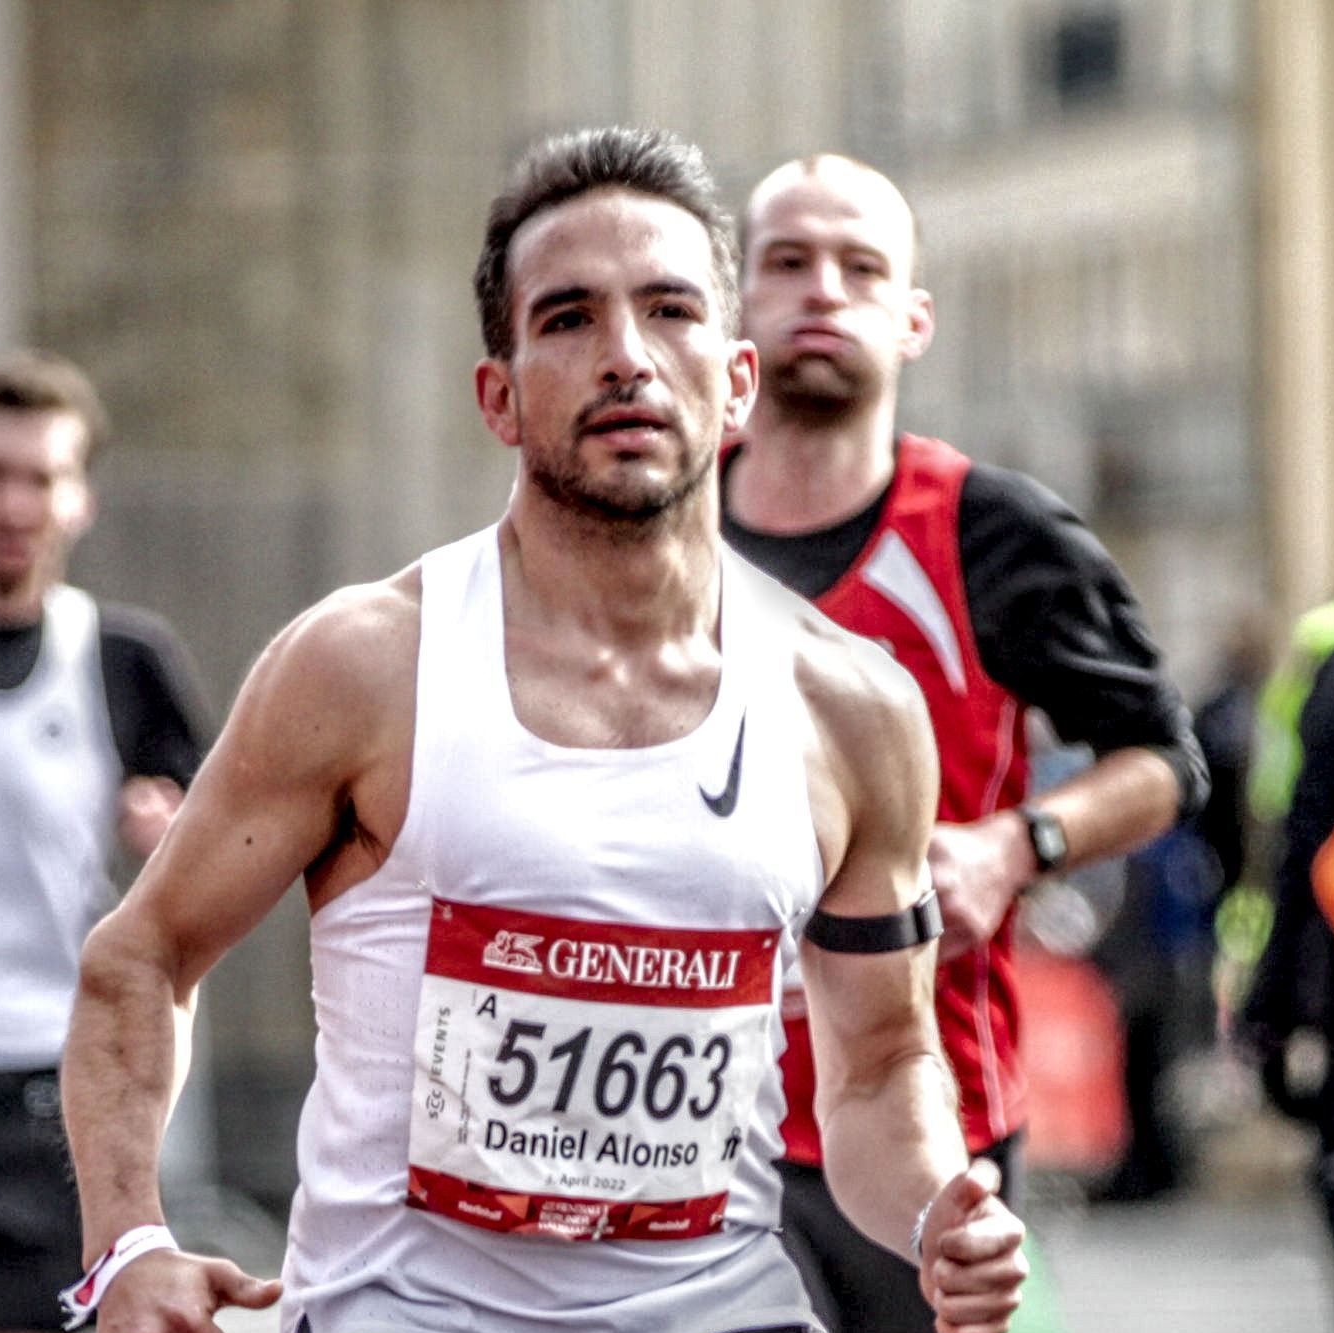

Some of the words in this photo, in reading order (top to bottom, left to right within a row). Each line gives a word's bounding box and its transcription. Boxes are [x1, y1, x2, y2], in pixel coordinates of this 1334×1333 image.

[548, 938, 741, 989] GENERALI
[477, 993, 497, 1019] A
[431, 1007, 450, 1077] EVENTS
[487, 1019, 732, 1122] 51663
[485, 1119, 588, 1161] Daniel
[596, 1134, 699, 1168] Alonso
[593, 1175, 627, 1192] 2022
